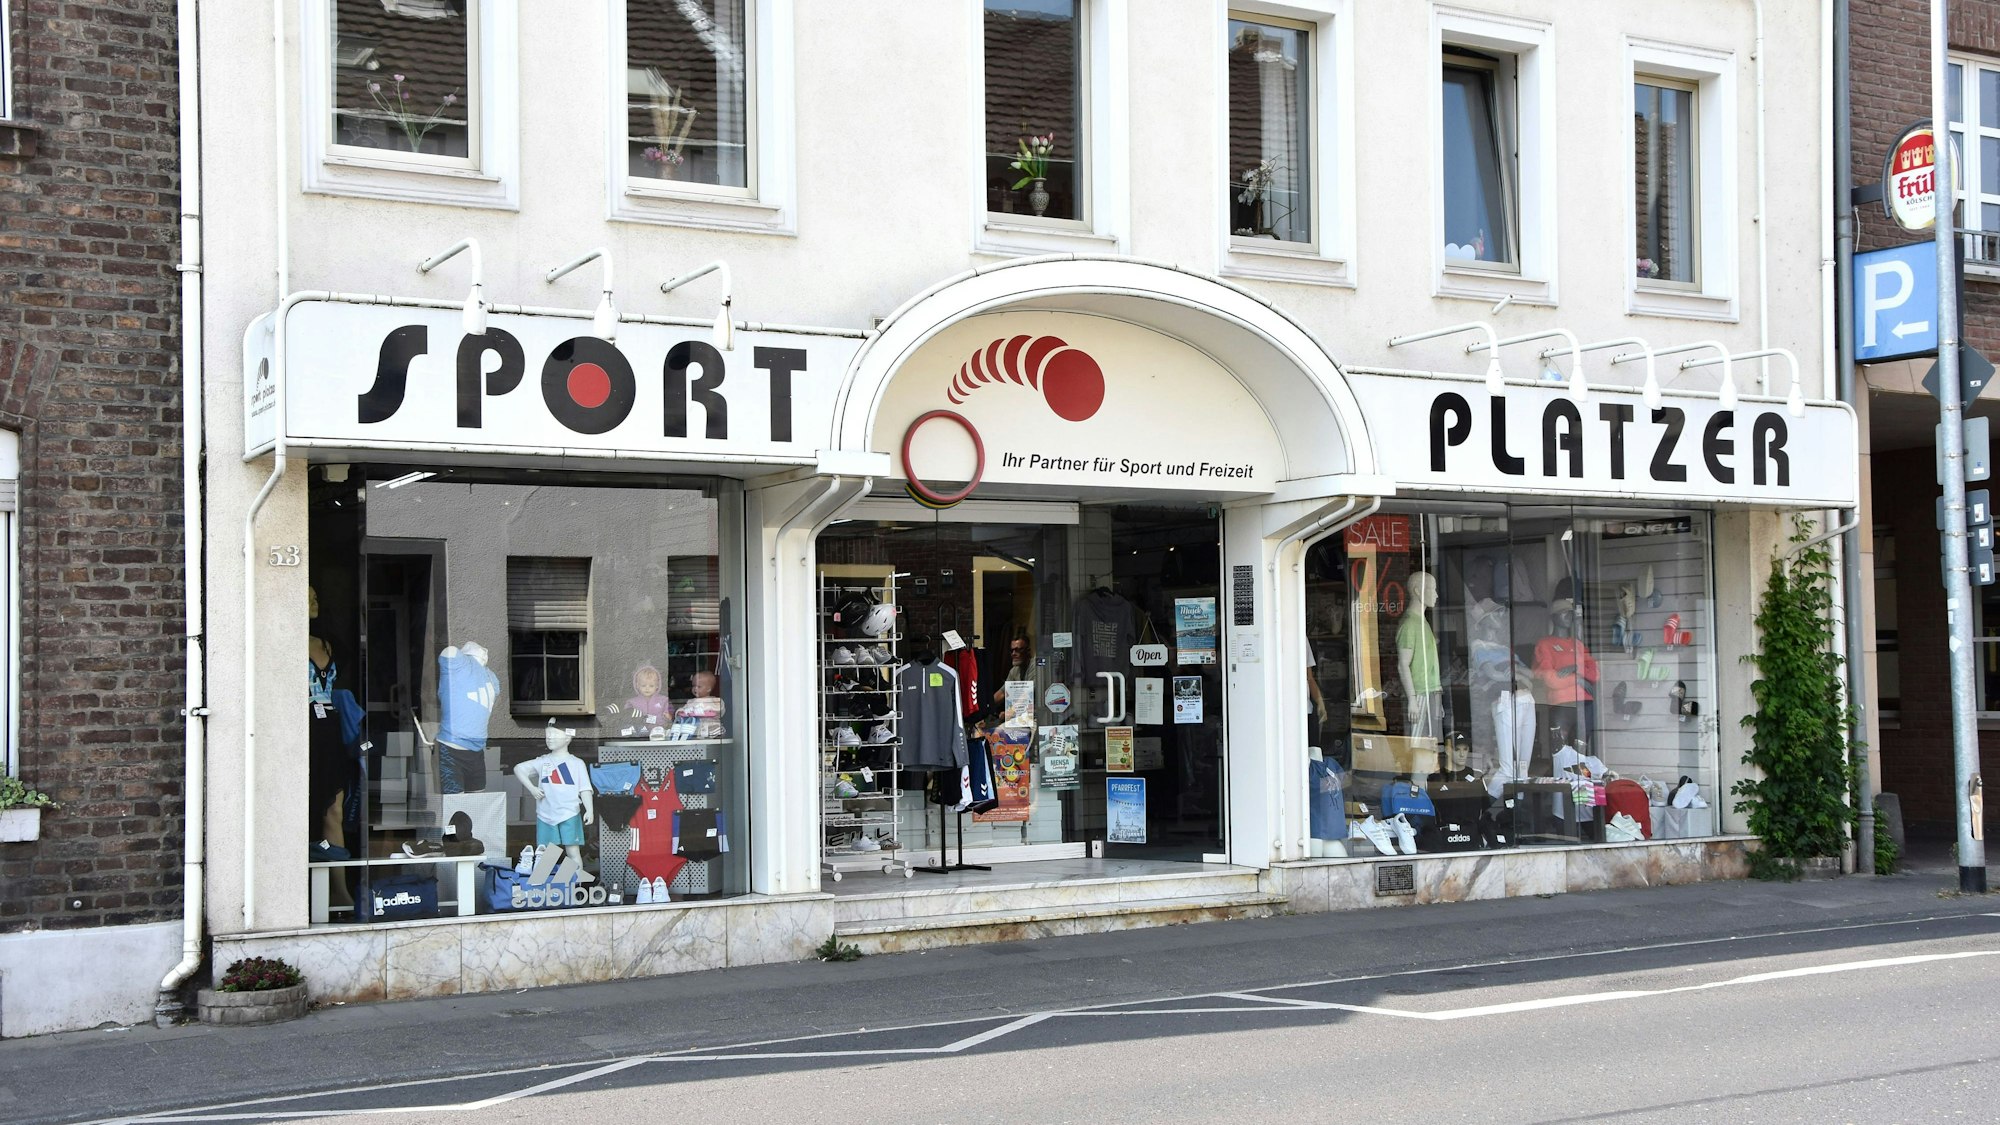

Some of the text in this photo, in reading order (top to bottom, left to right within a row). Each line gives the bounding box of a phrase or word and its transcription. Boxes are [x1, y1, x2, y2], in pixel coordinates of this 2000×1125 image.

[1863, 260, 1914, 349] P
[358, 324, 807, 442] SPORT
[1430, 391, 1790, 487] PLATZER
[1002, 452, 1254, 479] Ihr Partner für Sport und Freizeit
[1349, 521, 1403, 547] SALE
[269, 545, 301, 567] 53
[1136, 648, 1163, 664] Open
[1050, 759, 1070, 767] MENSA
[1111, 783, 1141, 793] PFARRFEST
[1447, 834, 1471, 843] adidas
